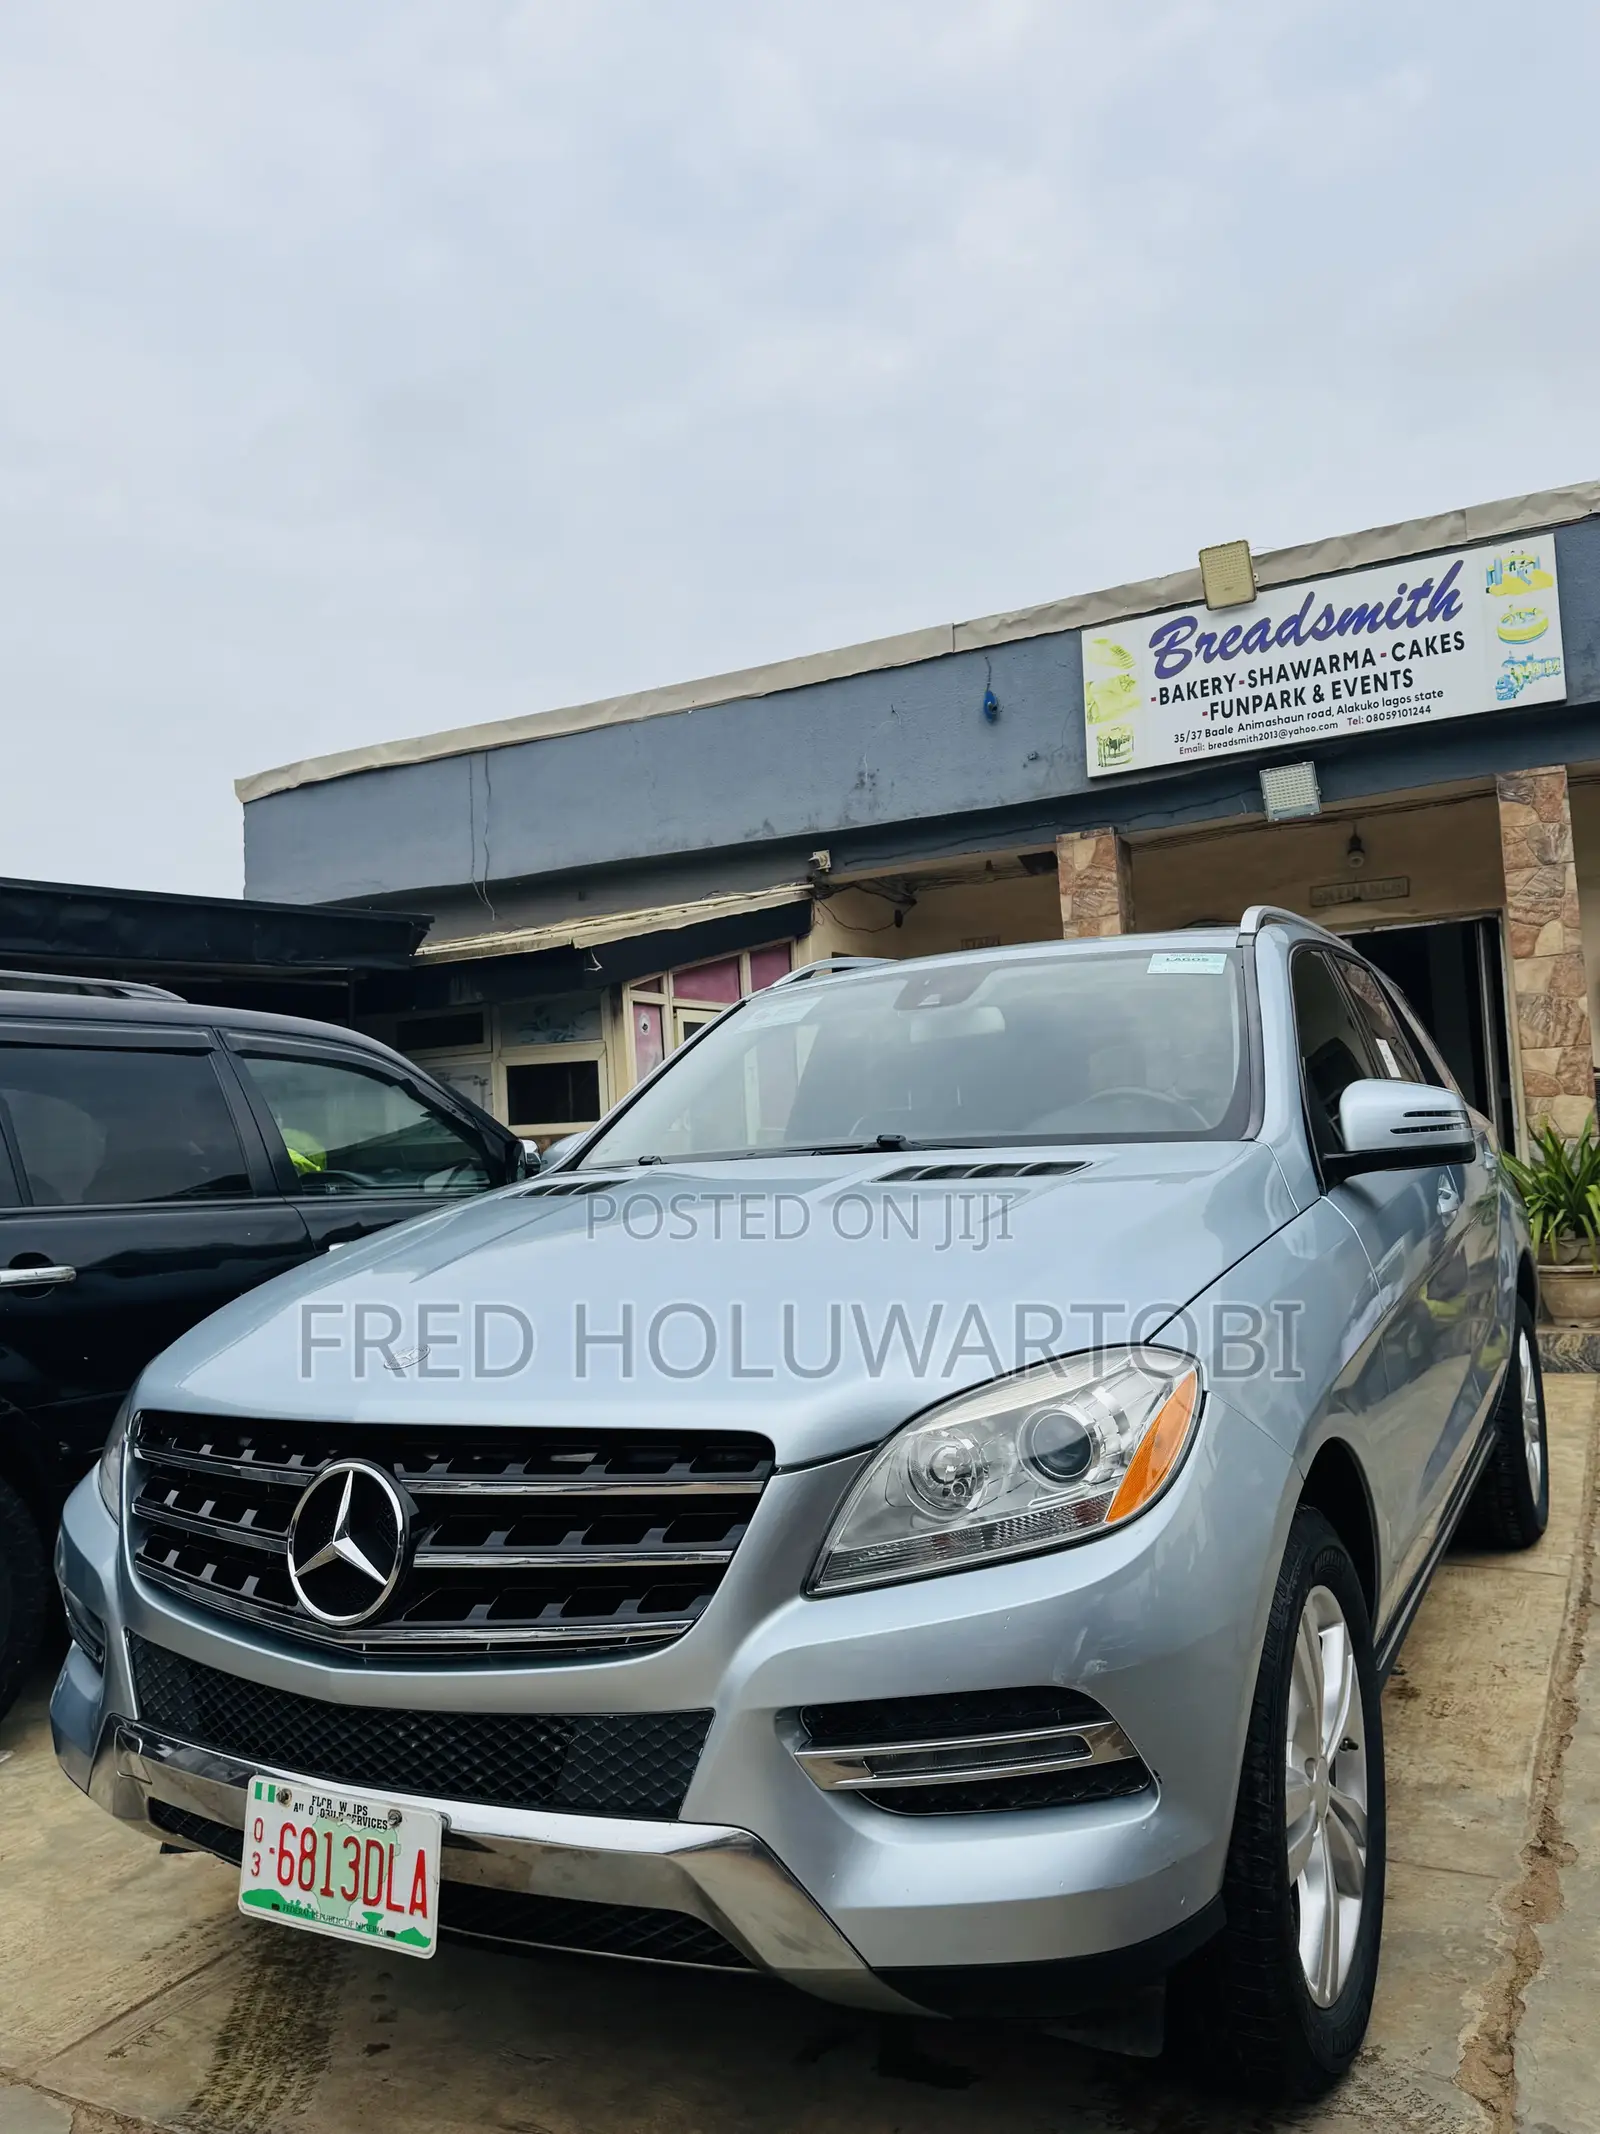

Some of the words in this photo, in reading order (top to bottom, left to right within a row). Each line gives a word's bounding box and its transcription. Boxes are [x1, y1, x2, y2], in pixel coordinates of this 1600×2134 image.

[1149, 560, 1464, 679] Breadsmith
[1312, 684, 1325, 703] &
[1331, 668, 1414, 700] EVENTS
[1174, 730, 1203, 743] 35/37
[1205, 725, 1233, 738] Baale
[1237, 713, 1304, 732] Animashaun
[1337, 700, 1379, 715] Alakuko
[1414, 689, 1444, 702] state
[1179, 742, 1205, 754] Email:
[1208, 722, 1338, 750] breadsmith2013@yahoo.com
[1347, 716, 1364, 726] Tel:
[1366, 705, 1431, 723] 08059101244
